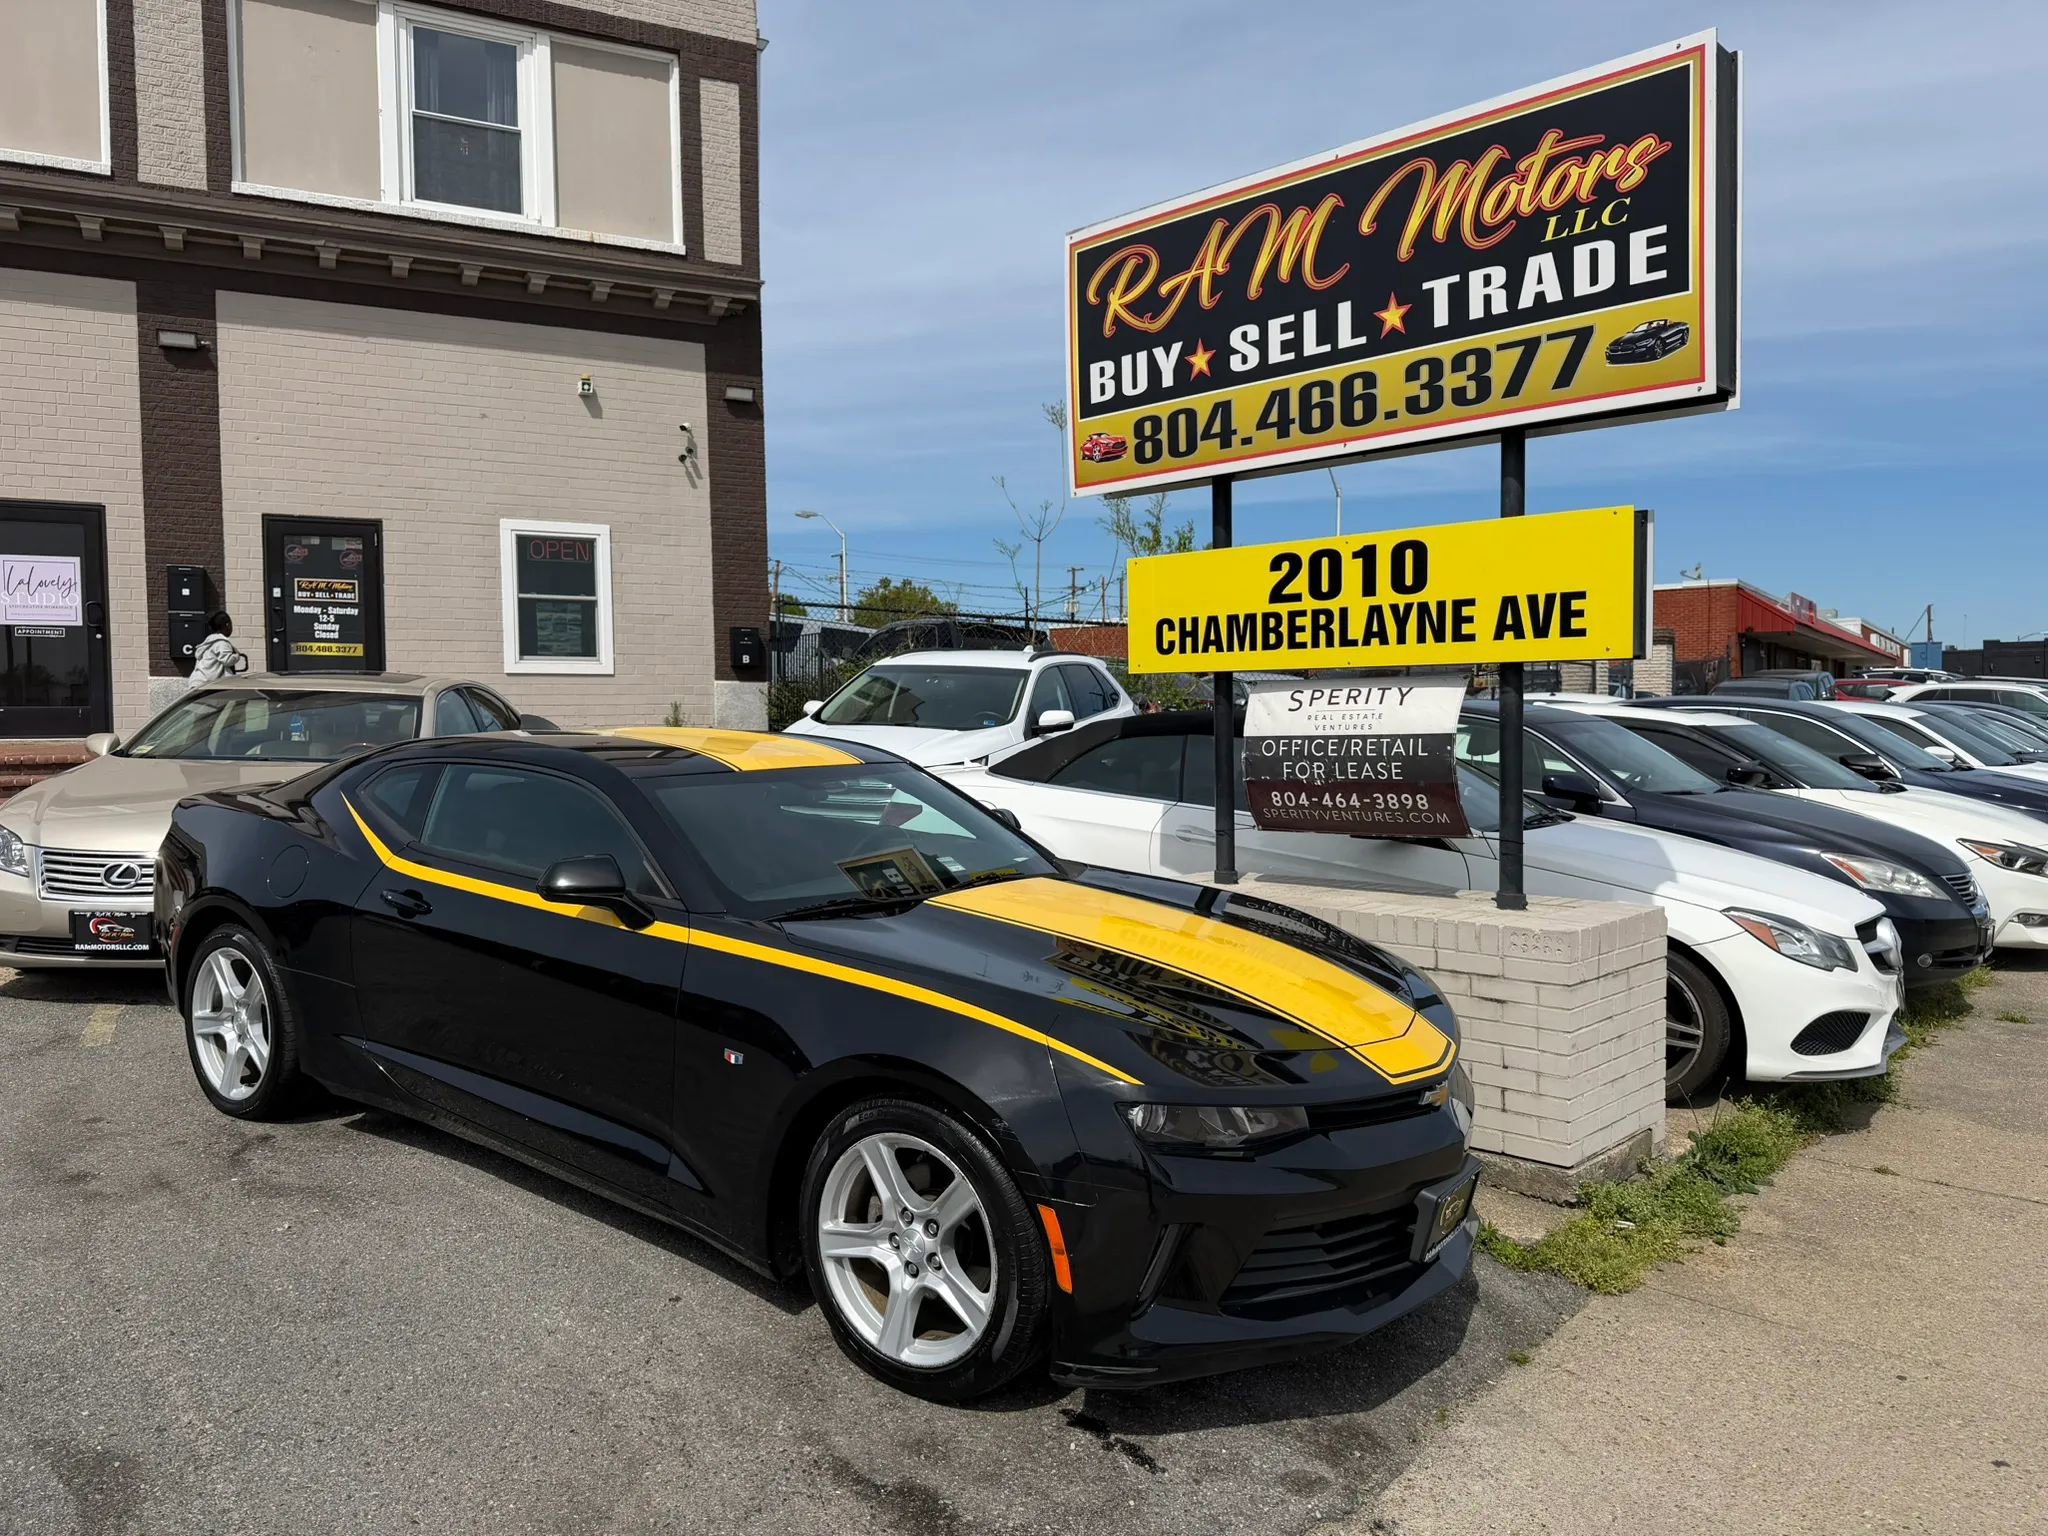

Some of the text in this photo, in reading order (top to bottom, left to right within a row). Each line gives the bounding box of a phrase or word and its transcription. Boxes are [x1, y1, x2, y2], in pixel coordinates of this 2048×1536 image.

[1540, 197, 1631, 243] LLC
[1088, 128, 1672, 338] RAM Motors
[1090, 224, 1668, 404] BUY SELL TRADE
[1133, 325, 1596, 465] 804.466.3377
[530, 539, 590, 561] OPEN
[1268, 539, 1429, 604] 2010
[293, 605, 322, 615] Monday
[327, 606, 359, 616] Saturday
[319, 614, 335, 622] 12-5
[313, 622, 340, 631] Sunday
[1155, 590, 1588, 656] CHAMBERLAYNE AVE
[314, 630, 339, 639] Closed
[182, 644, 193, 655] C
[742, 654, 750, 664] B
[1288, 687, 1415, 712] SPERITY
[1314, 723, 1374, 731] VENTURES
[1261, 738, 1429, 756] OFFICE/RETAIL
[1283, 761, 1404, 780] FOR LEASE
[1271, 791, 1430, 810] 804-464-3898
[1263, 807, 1451, 824] SPERITYVENTURES.COM
